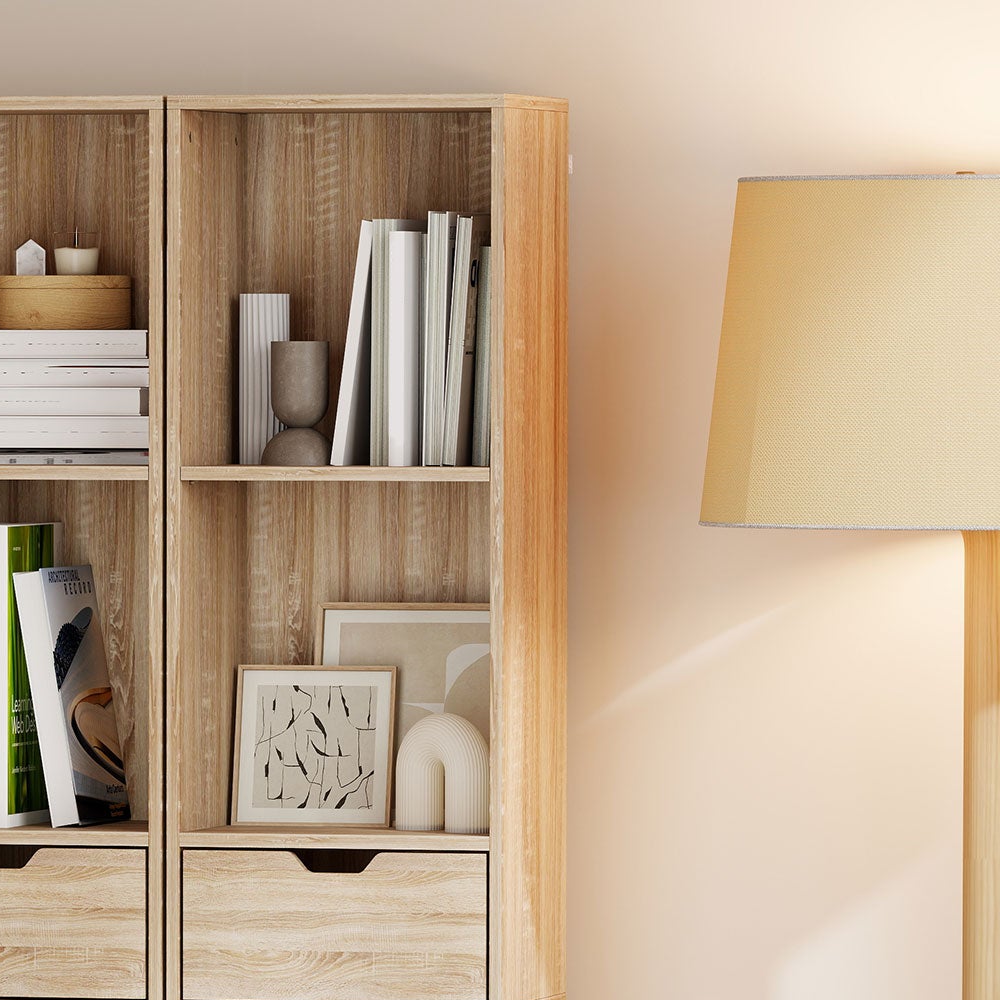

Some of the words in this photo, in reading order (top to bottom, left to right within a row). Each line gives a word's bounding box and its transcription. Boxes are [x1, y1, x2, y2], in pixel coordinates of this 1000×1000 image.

[64, 581, 91, 595] RECORD
[11, 714, 24, 734] Web
[25, 714, 36, 733] Des
